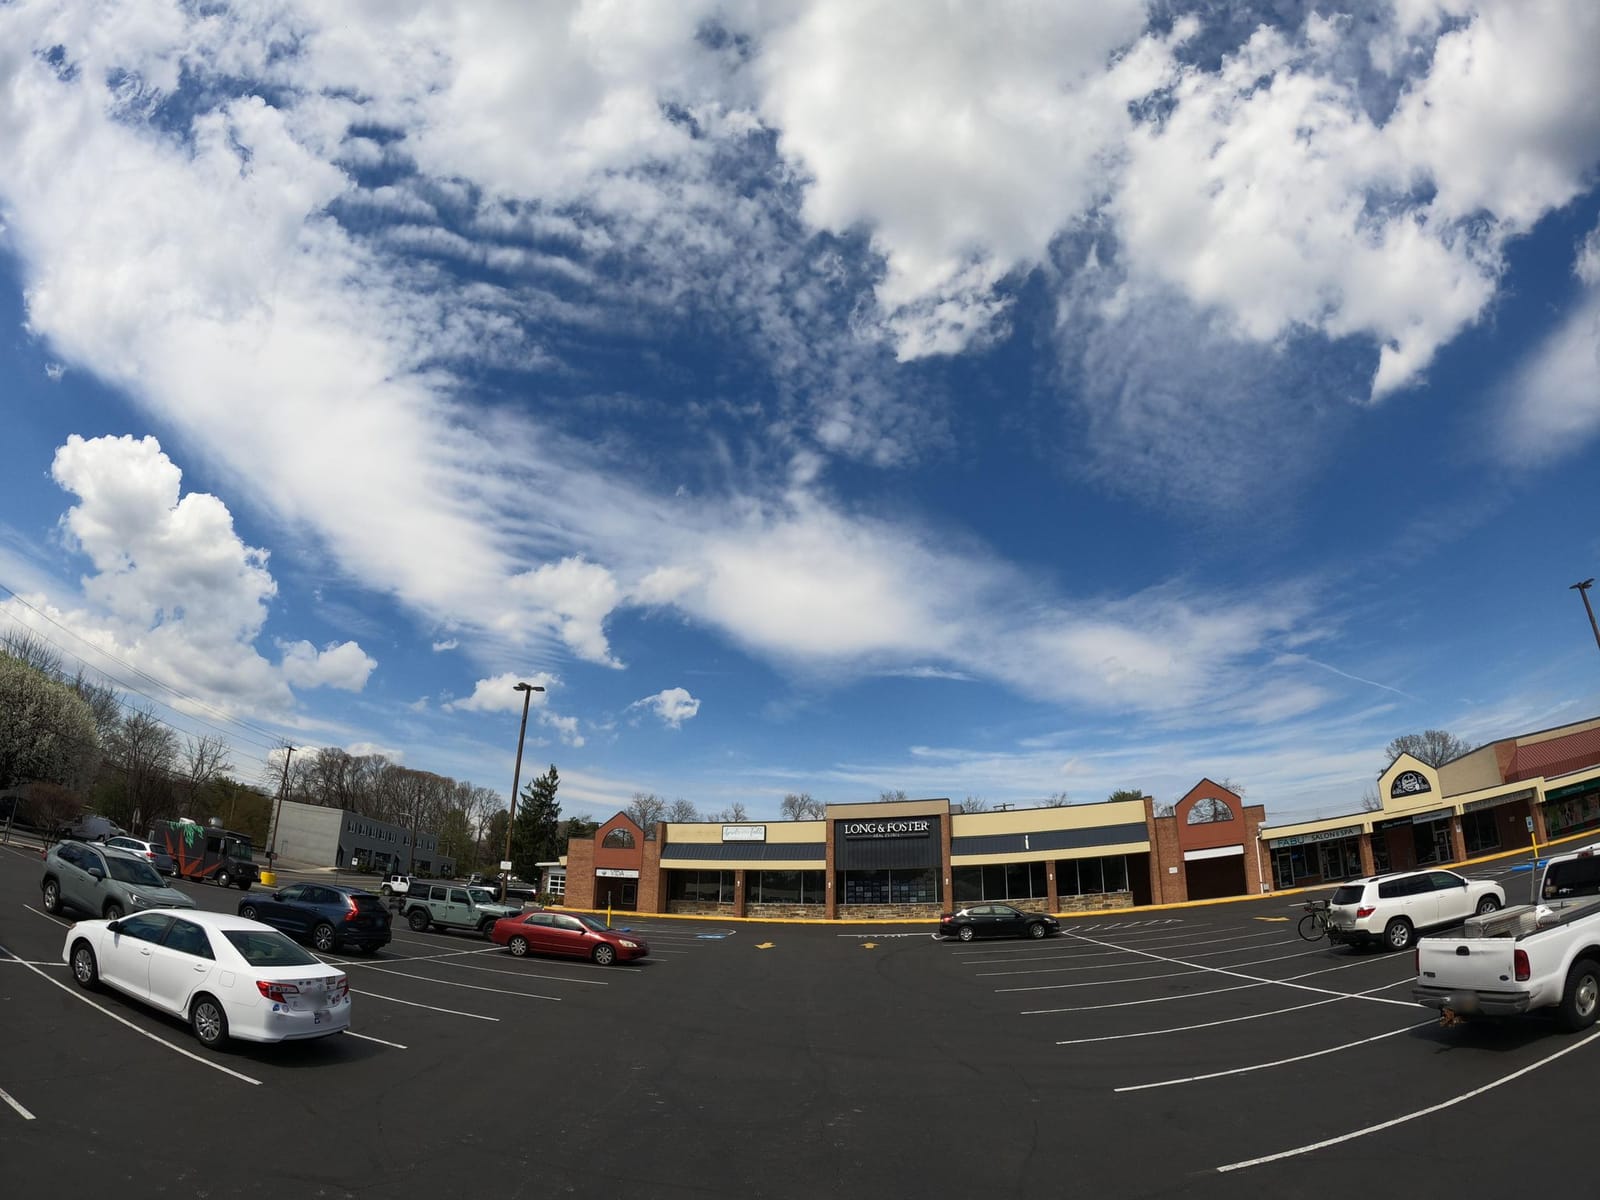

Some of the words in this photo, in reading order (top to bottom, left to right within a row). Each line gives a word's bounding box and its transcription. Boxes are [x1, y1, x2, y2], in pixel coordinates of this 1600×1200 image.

[844, 823, 876, 834] LONG
[877, 823, 885, 833] &
[887, 821, 929, 832] FOSTER
[1311, 832, 1336, 841] SALON
[1340, 828, 1353, 837] SPA
